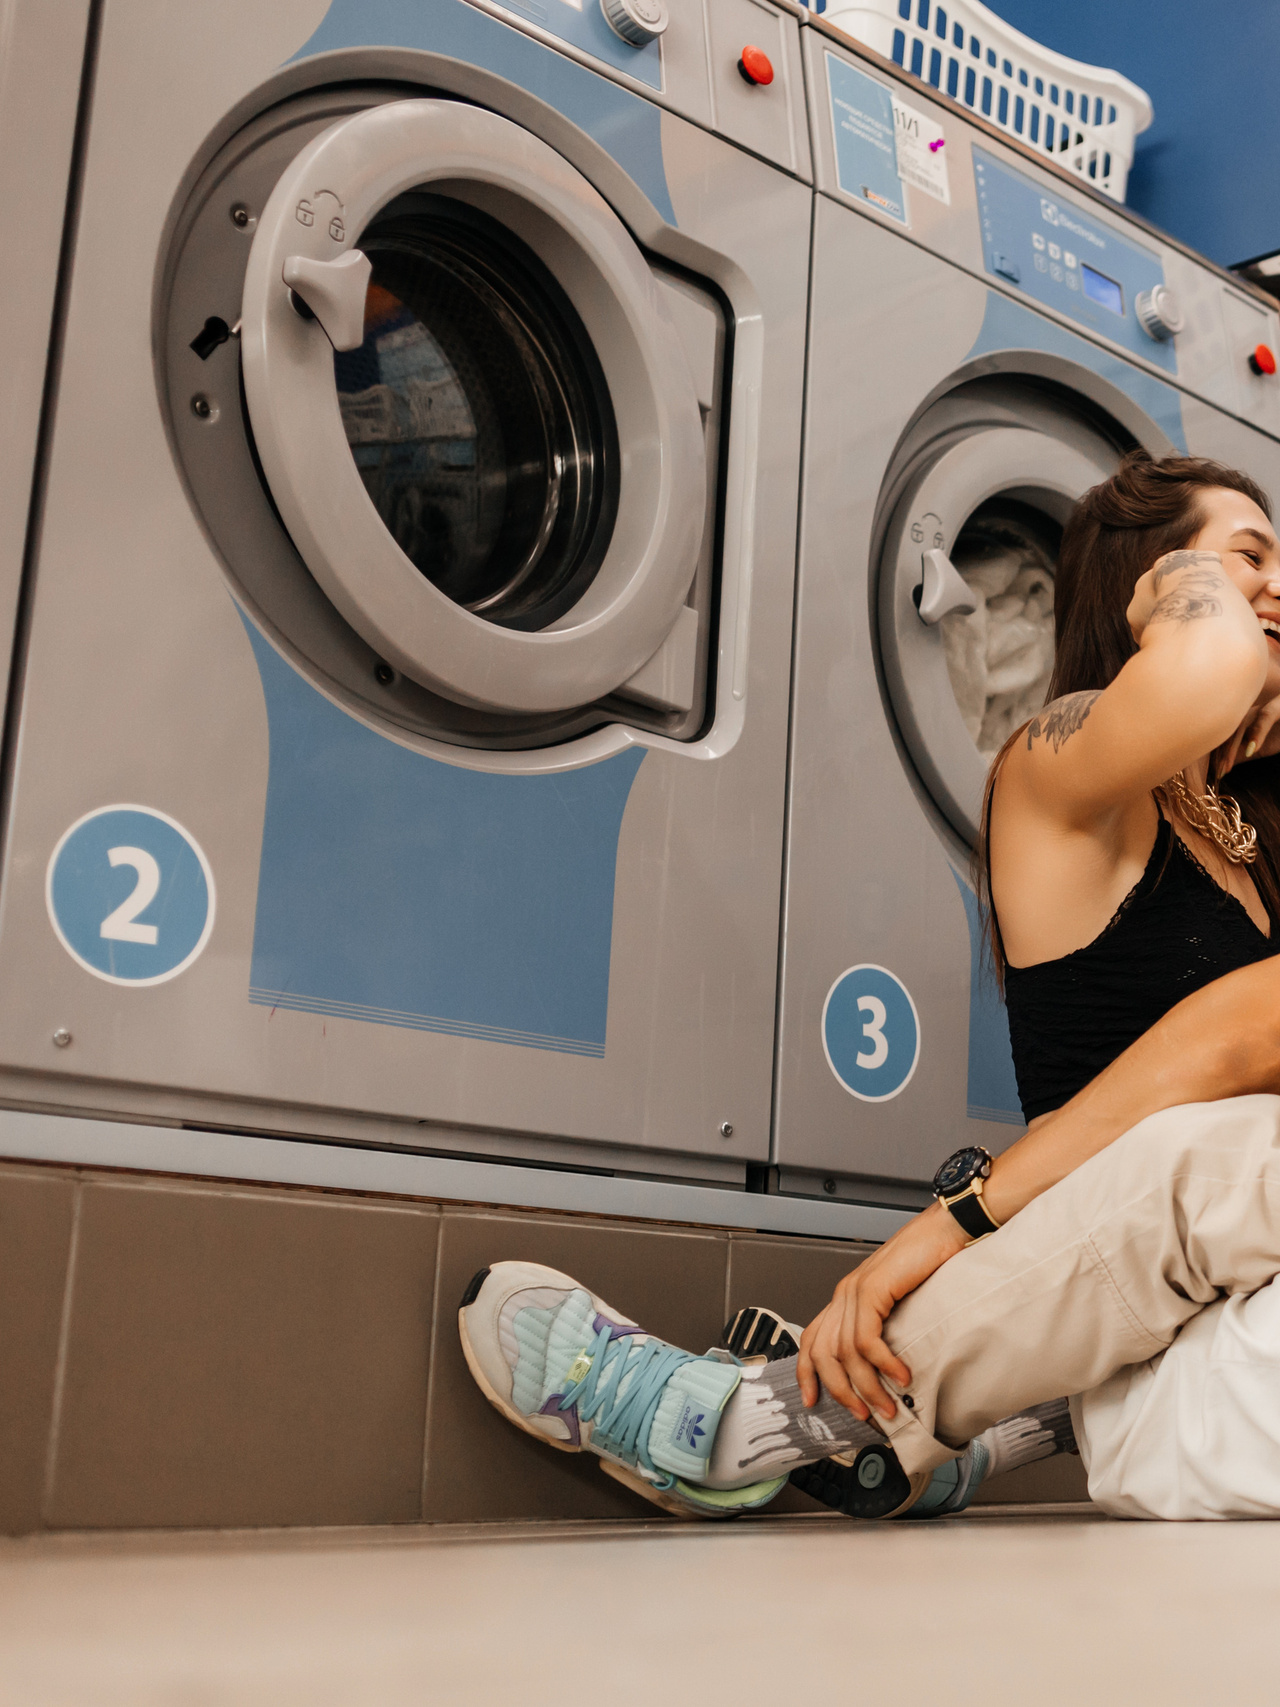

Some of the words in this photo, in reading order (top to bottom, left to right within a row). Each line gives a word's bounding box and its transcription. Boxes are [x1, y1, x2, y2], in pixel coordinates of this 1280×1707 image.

[894, 108, 919, 138] 11/1
[100, 846, 160, 945] 2
[856, 995, 889, 1070] 3
[676, 1406, 691, 1441] adidas
